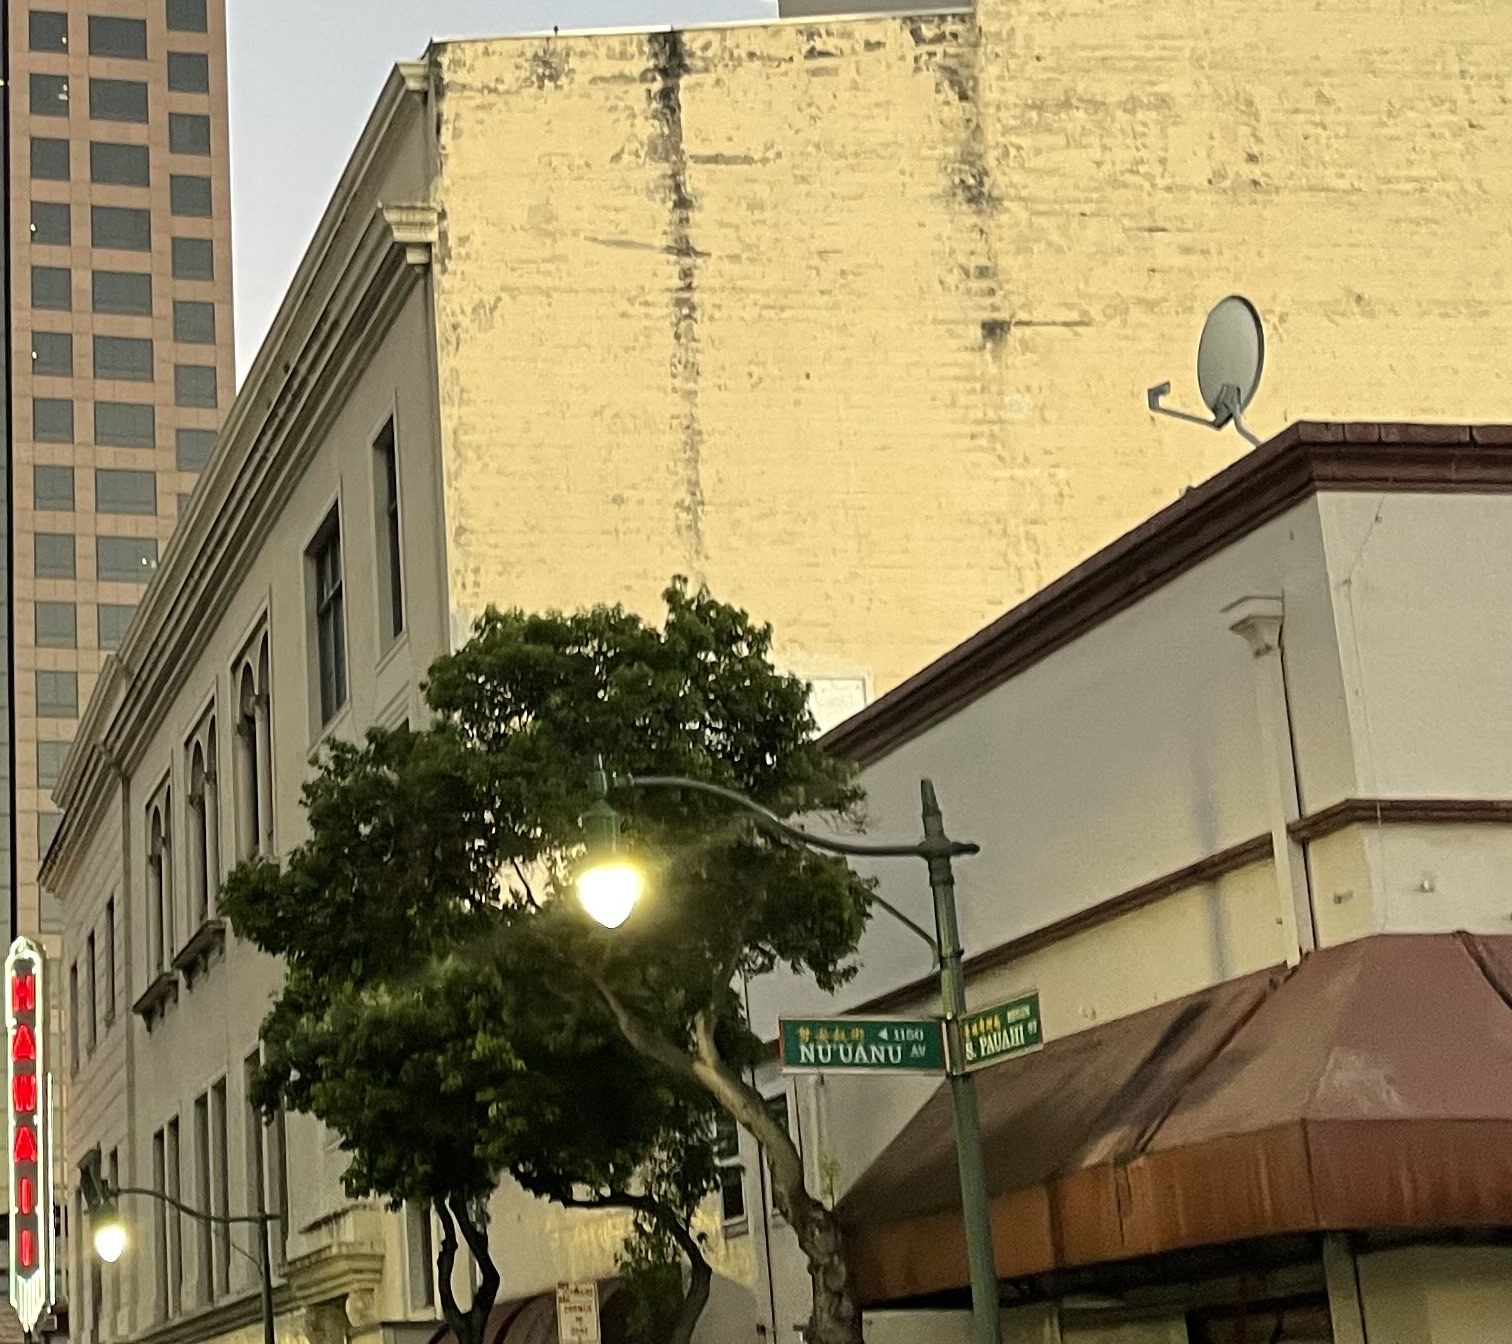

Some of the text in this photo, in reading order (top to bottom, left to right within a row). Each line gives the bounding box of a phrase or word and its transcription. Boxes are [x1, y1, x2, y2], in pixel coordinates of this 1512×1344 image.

[910, 1044, 927, 1058] AV
[979, 1023, 1025, 1057] PAUAHI
[12, 975, 37, 1267] HAWAII
